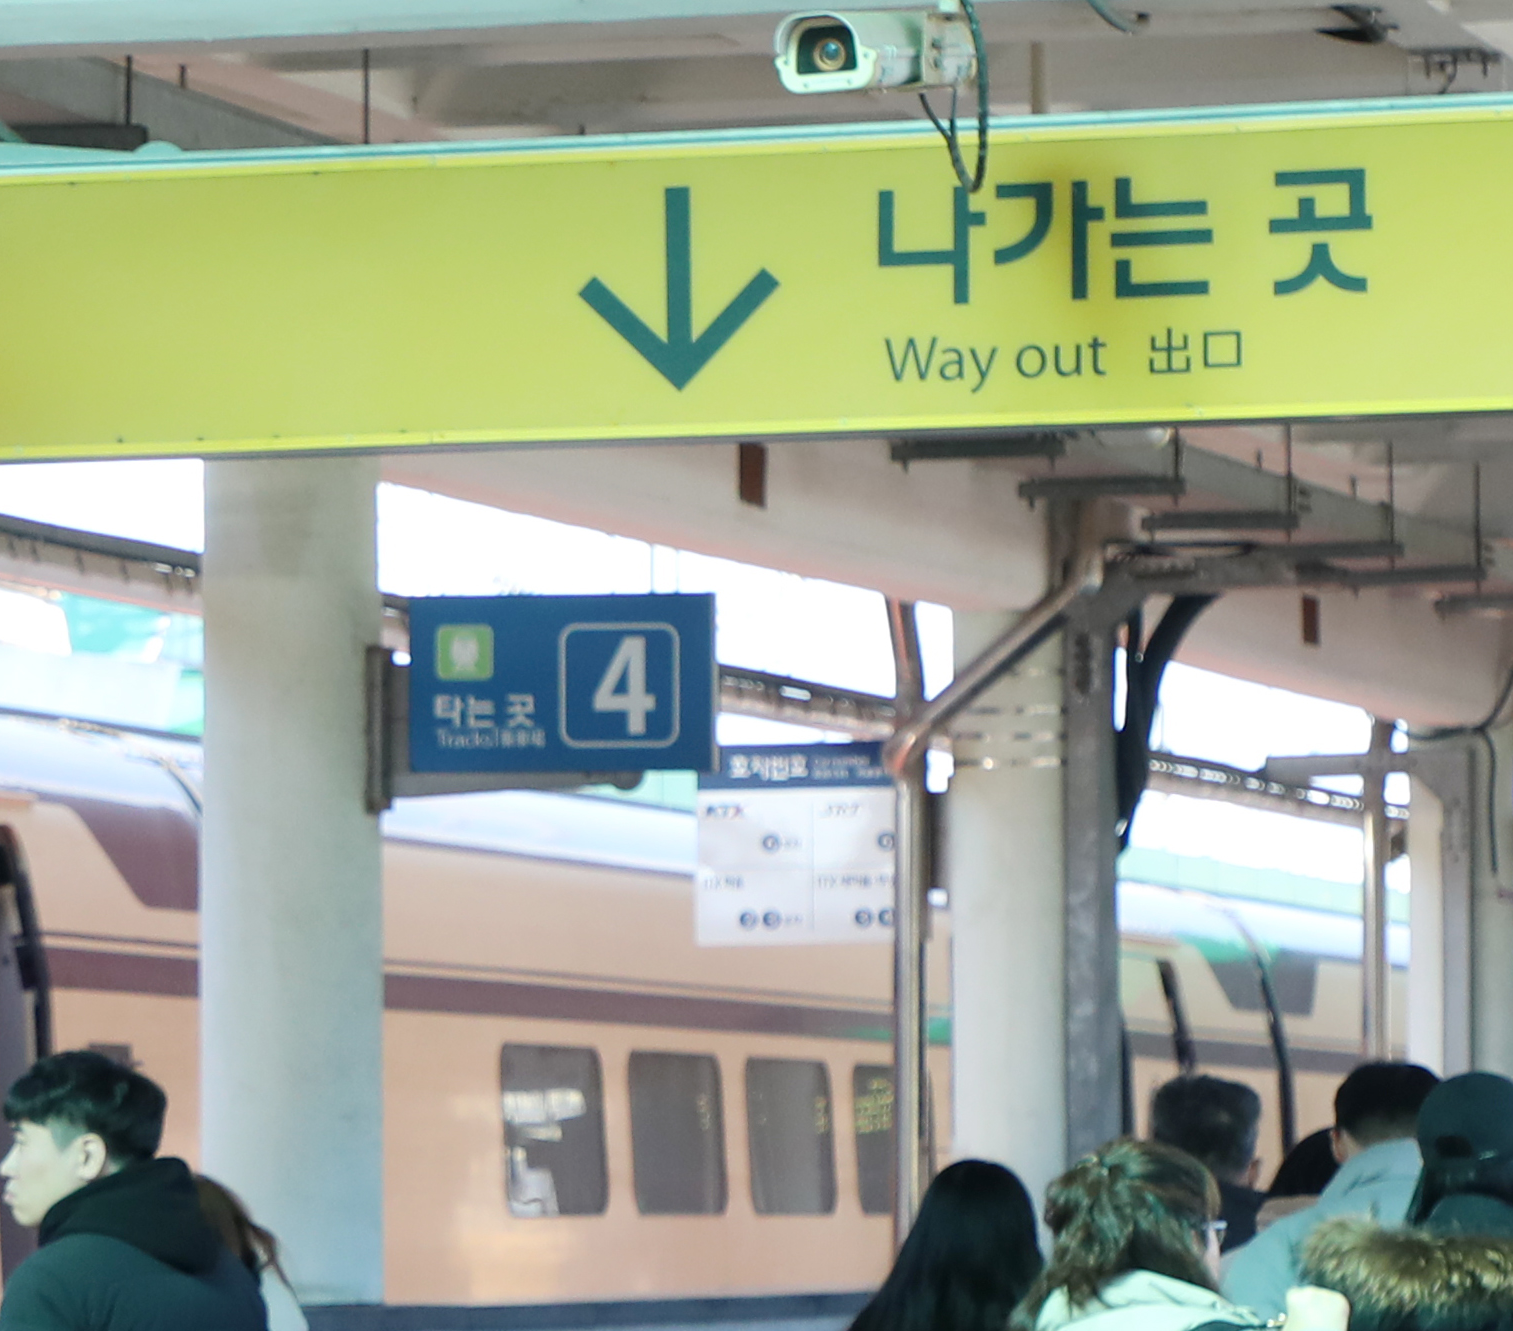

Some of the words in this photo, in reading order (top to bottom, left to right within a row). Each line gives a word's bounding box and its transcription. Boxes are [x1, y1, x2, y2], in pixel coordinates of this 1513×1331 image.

[877, 176, 1214, 305] 나가는
[1268, 168, 1373, 296] 곳
[884, 334, 999, 393] Way
[1015, 336, 1108, 379] out
[1149, 327, 1243, 375] 出口
[433, 693, 496, 728] 타는
[506, 693, 536, 728] 곳
[592, 635, 657, 736] 4
